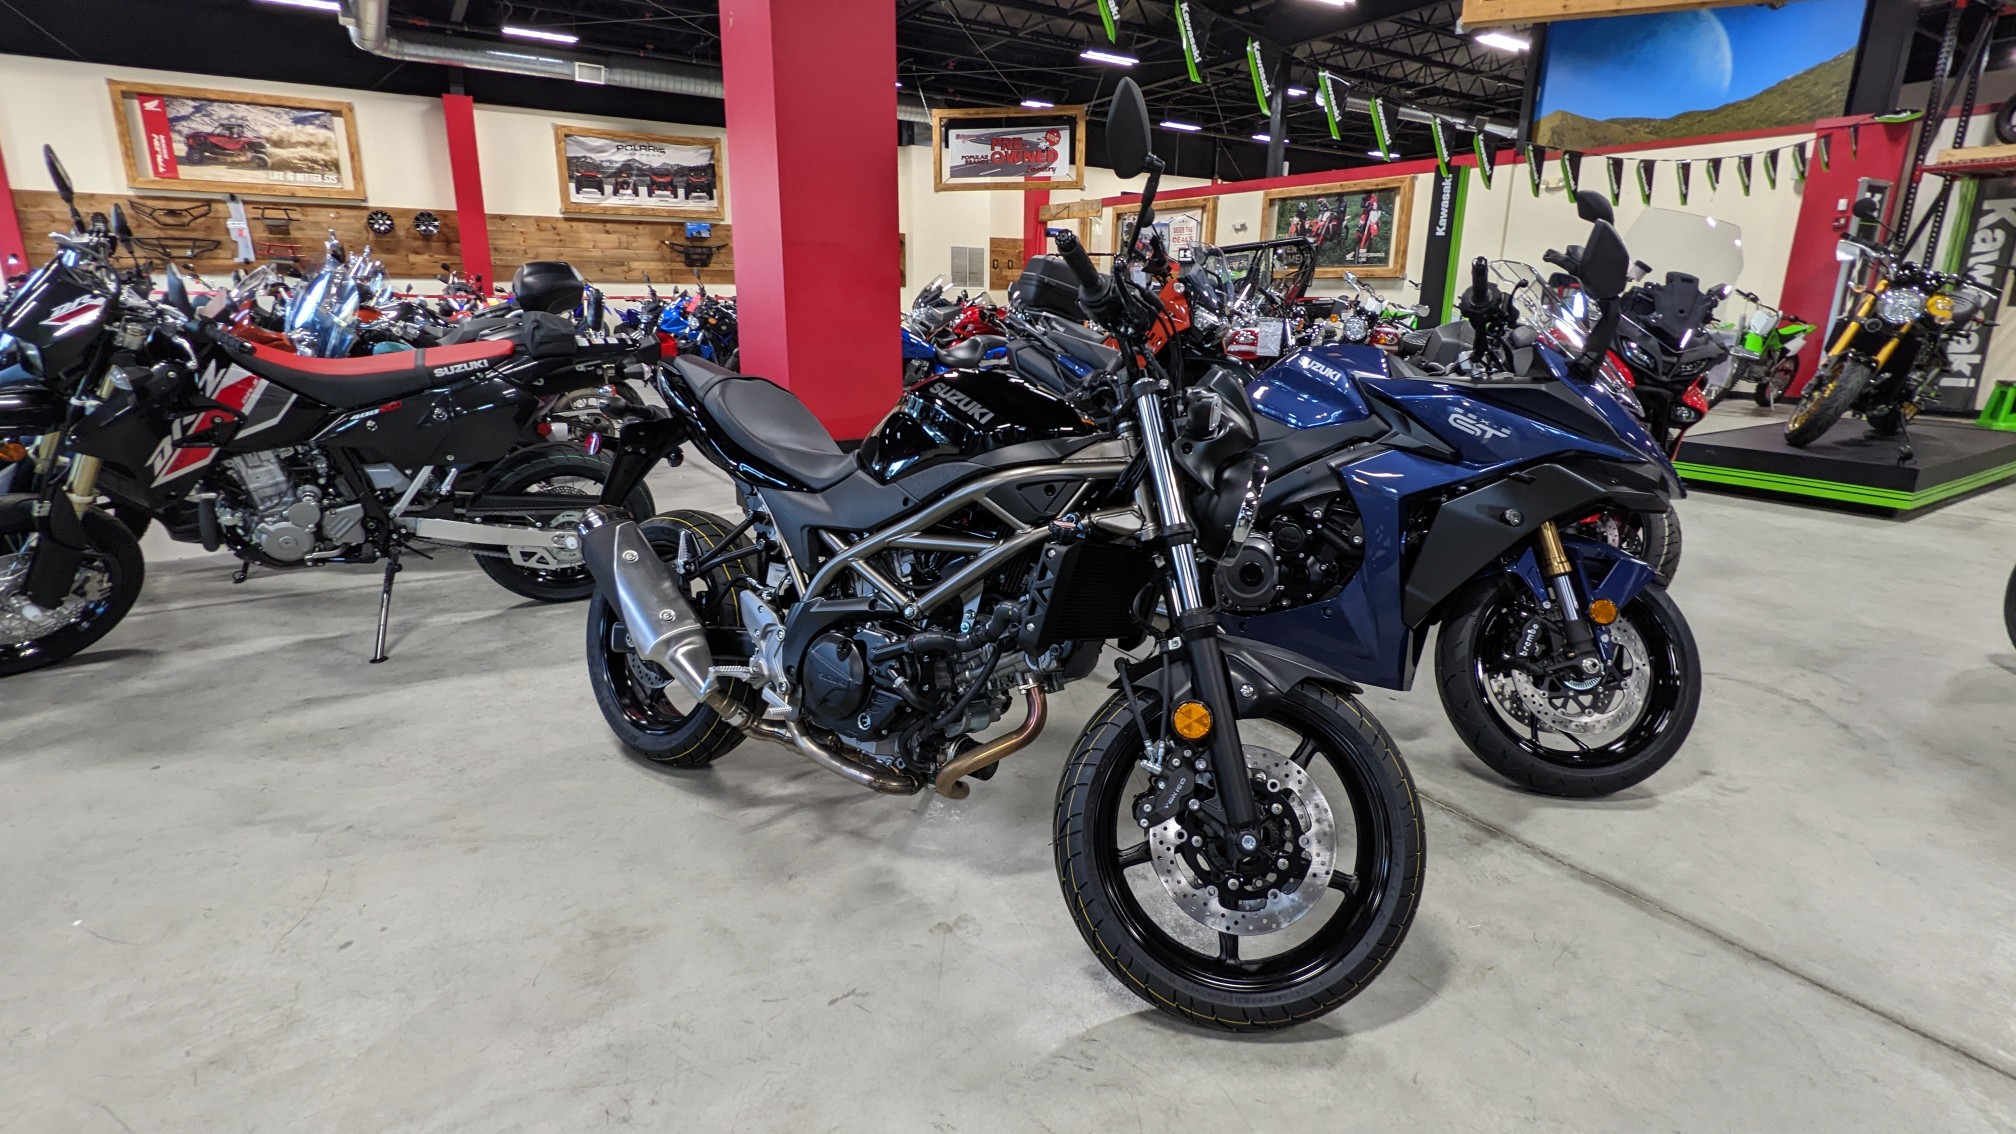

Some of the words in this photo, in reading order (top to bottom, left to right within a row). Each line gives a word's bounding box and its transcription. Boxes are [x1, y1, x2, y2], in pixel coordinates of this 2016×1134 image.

[1180, 2, 1202, 63] Kawasaki
[1252, 40, 1272, 97] Kawasaki
[1375, 96, 1392, 146] Kawasaki
[616, 144, 666, 154] POLARIS
[990, 137, 1028, 151] PRE-
[990, 149, 1059, 165] OWNED
[268, 171, 285, 180] LIFE
[286, 172, 295, 181] IS
[296, 173, 323, 182] BETTER
[433, 358, 490, 377] SUZUKI
[1298, 355, 1342, 382] SUZUKI
[928, 381, 995, 425] SUZUKI
[1519, 622, 1539, 657] brembo
[1163, 777, 1187, 809] TOKICO
